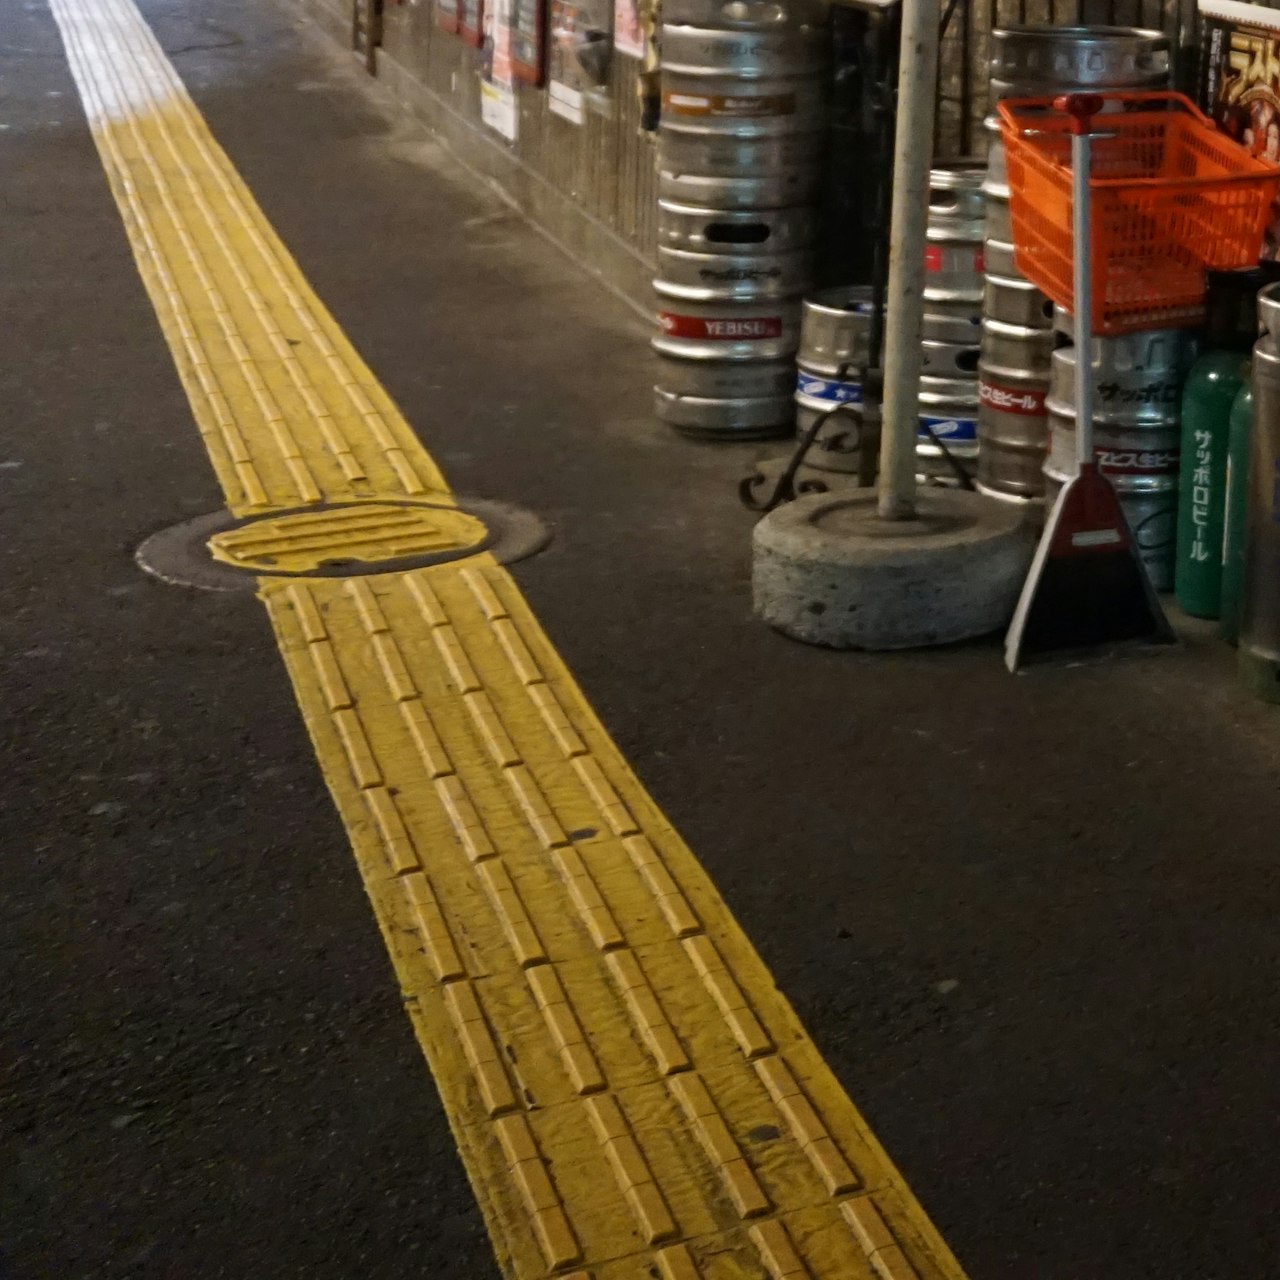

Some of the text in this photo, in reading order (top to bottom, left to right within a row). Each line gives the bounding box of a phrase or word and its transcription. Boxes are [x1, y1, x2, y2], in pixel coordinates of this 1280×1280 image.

[704, 320, 768, 337] YEBISU
[1190, 428, 1213, 562] サッポロビール
